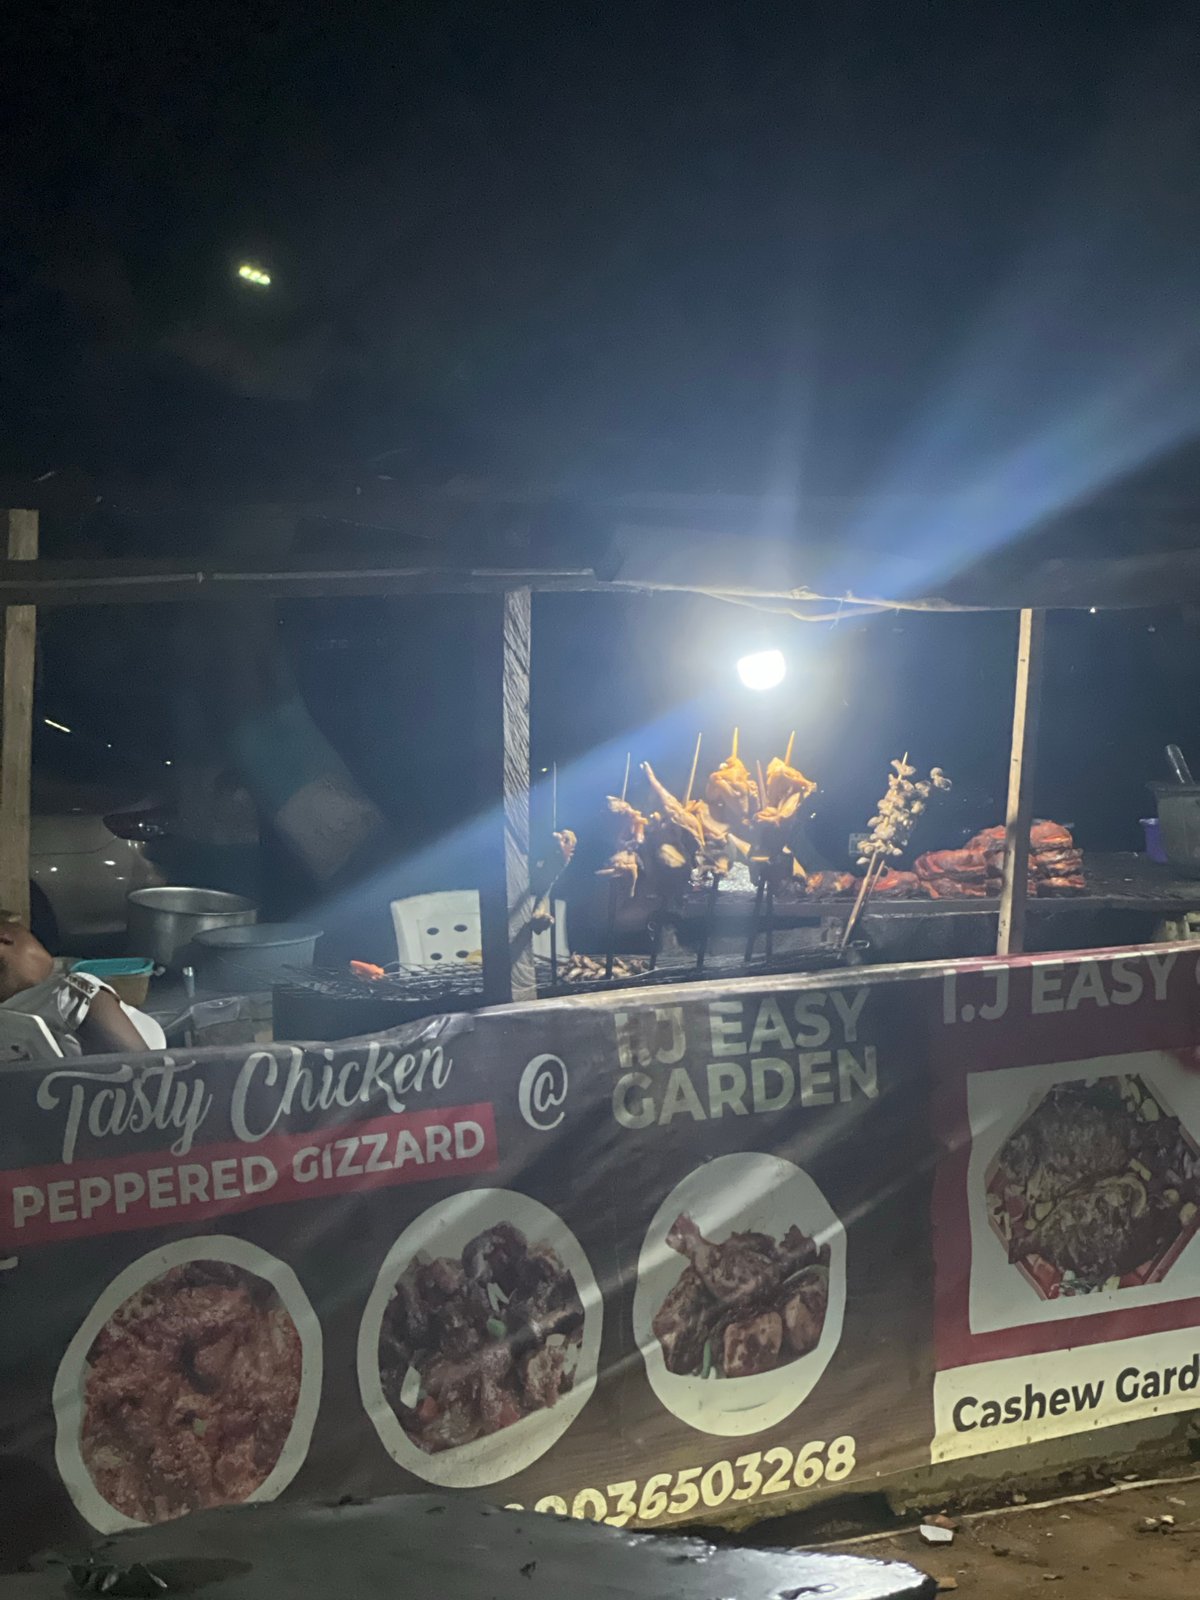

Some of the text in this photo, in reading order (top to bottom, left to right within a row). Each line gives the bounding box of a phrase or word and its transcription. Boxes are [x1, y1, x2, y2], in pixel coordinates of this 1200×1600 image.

[708, 987, 871, 1058] EASY
[1031, 951, 1178, 1014] EASY
[36, 1055, 213, 1164] Tasty
[230, 1041, 454, 1143] Chicken
[612, 1046, 880, 1130] GARDEN
[12, 1155, 278, 1228] PEPPERED
[952, 1353, 1200, 1433] Cashew Gard
[504, 1435, 856, 1528] 036503268
